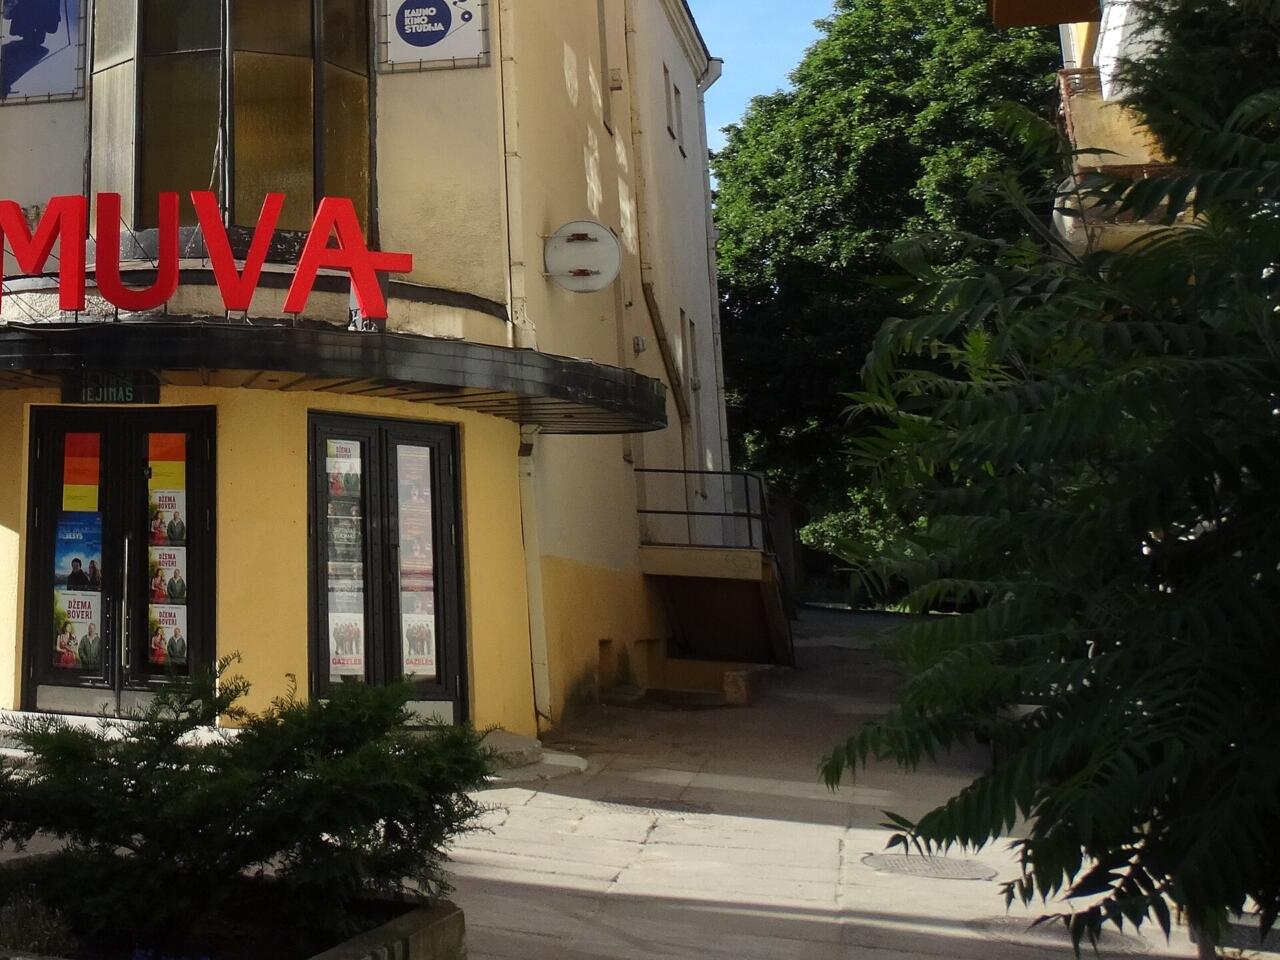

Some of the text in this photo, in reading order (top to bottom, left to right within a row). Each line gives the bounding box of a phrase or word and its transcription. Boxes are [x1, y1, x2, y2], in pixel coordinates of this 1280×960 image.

[404, 7, 437, 18] KAUNO
[404, 16, 429, 26] KINO
[404, 22, 445, 34] STUDIJA
